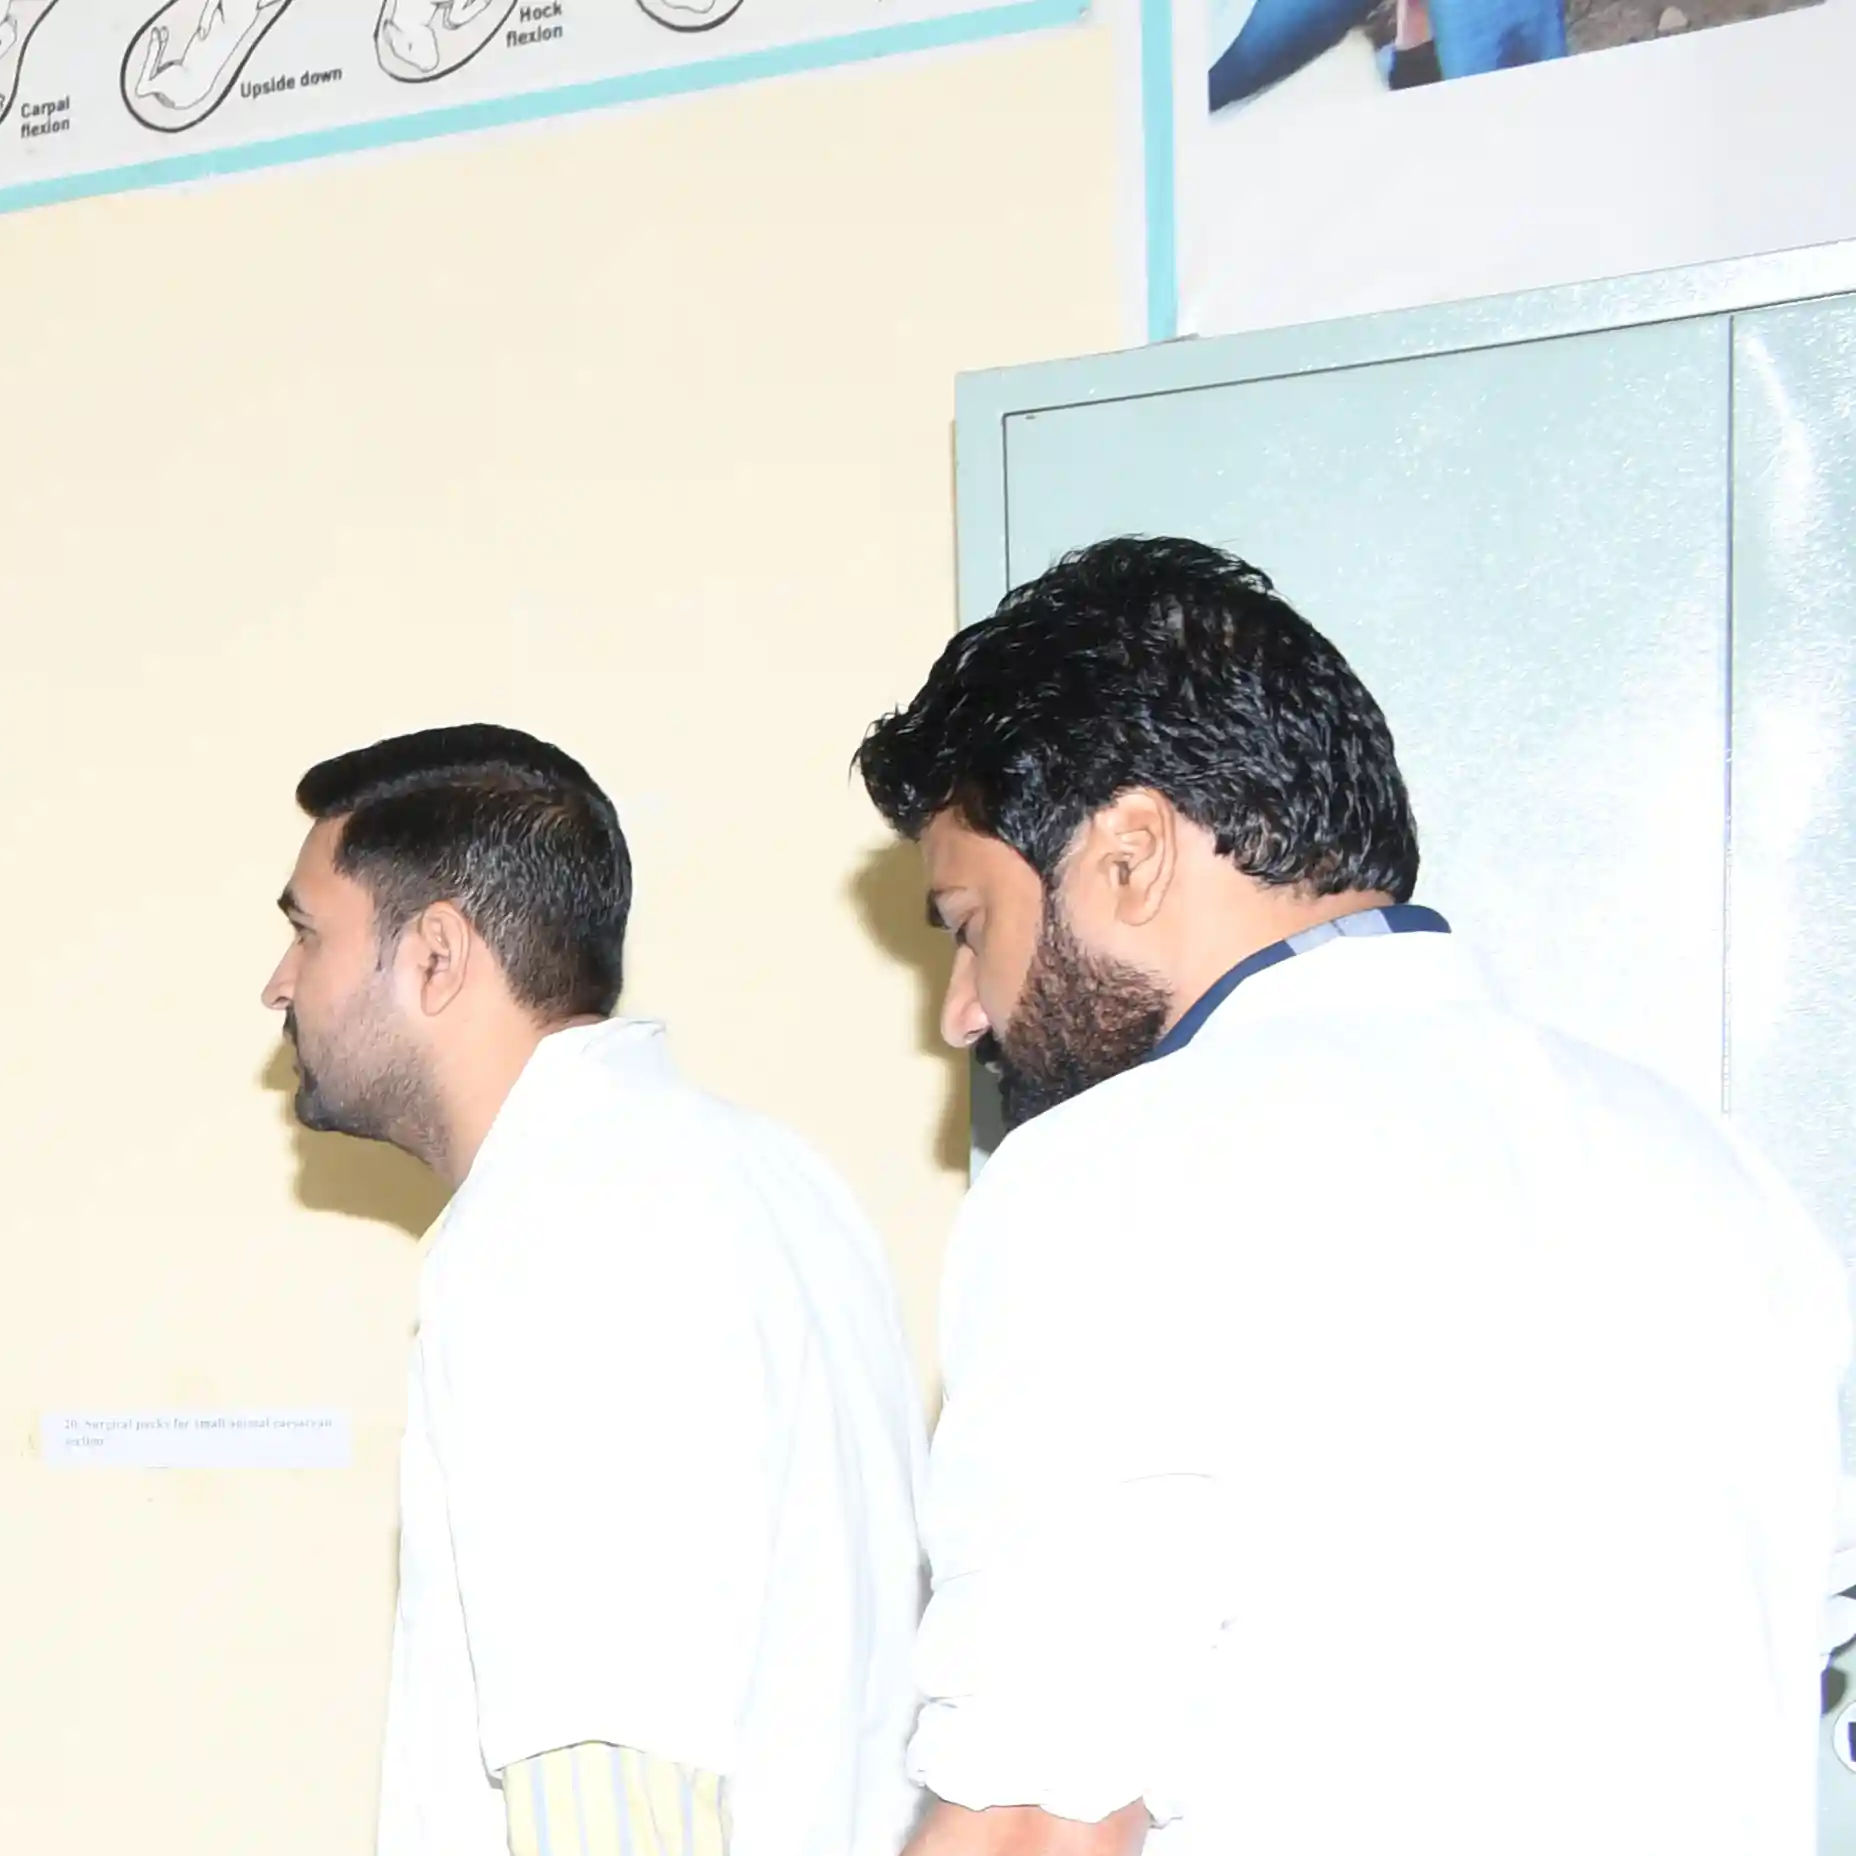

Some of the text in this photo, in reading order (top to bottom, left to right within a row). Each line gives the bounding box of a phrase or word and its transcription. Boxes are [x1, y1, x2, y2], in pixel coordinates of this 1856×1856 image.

[519, 0, 563, 23] Hock
[506, 25, 564, 48] flexion
[240, 67, 343, 100] Upside down
[20, 94, 71, 119] Carpal
[20, 116, 71, 139] flexion
